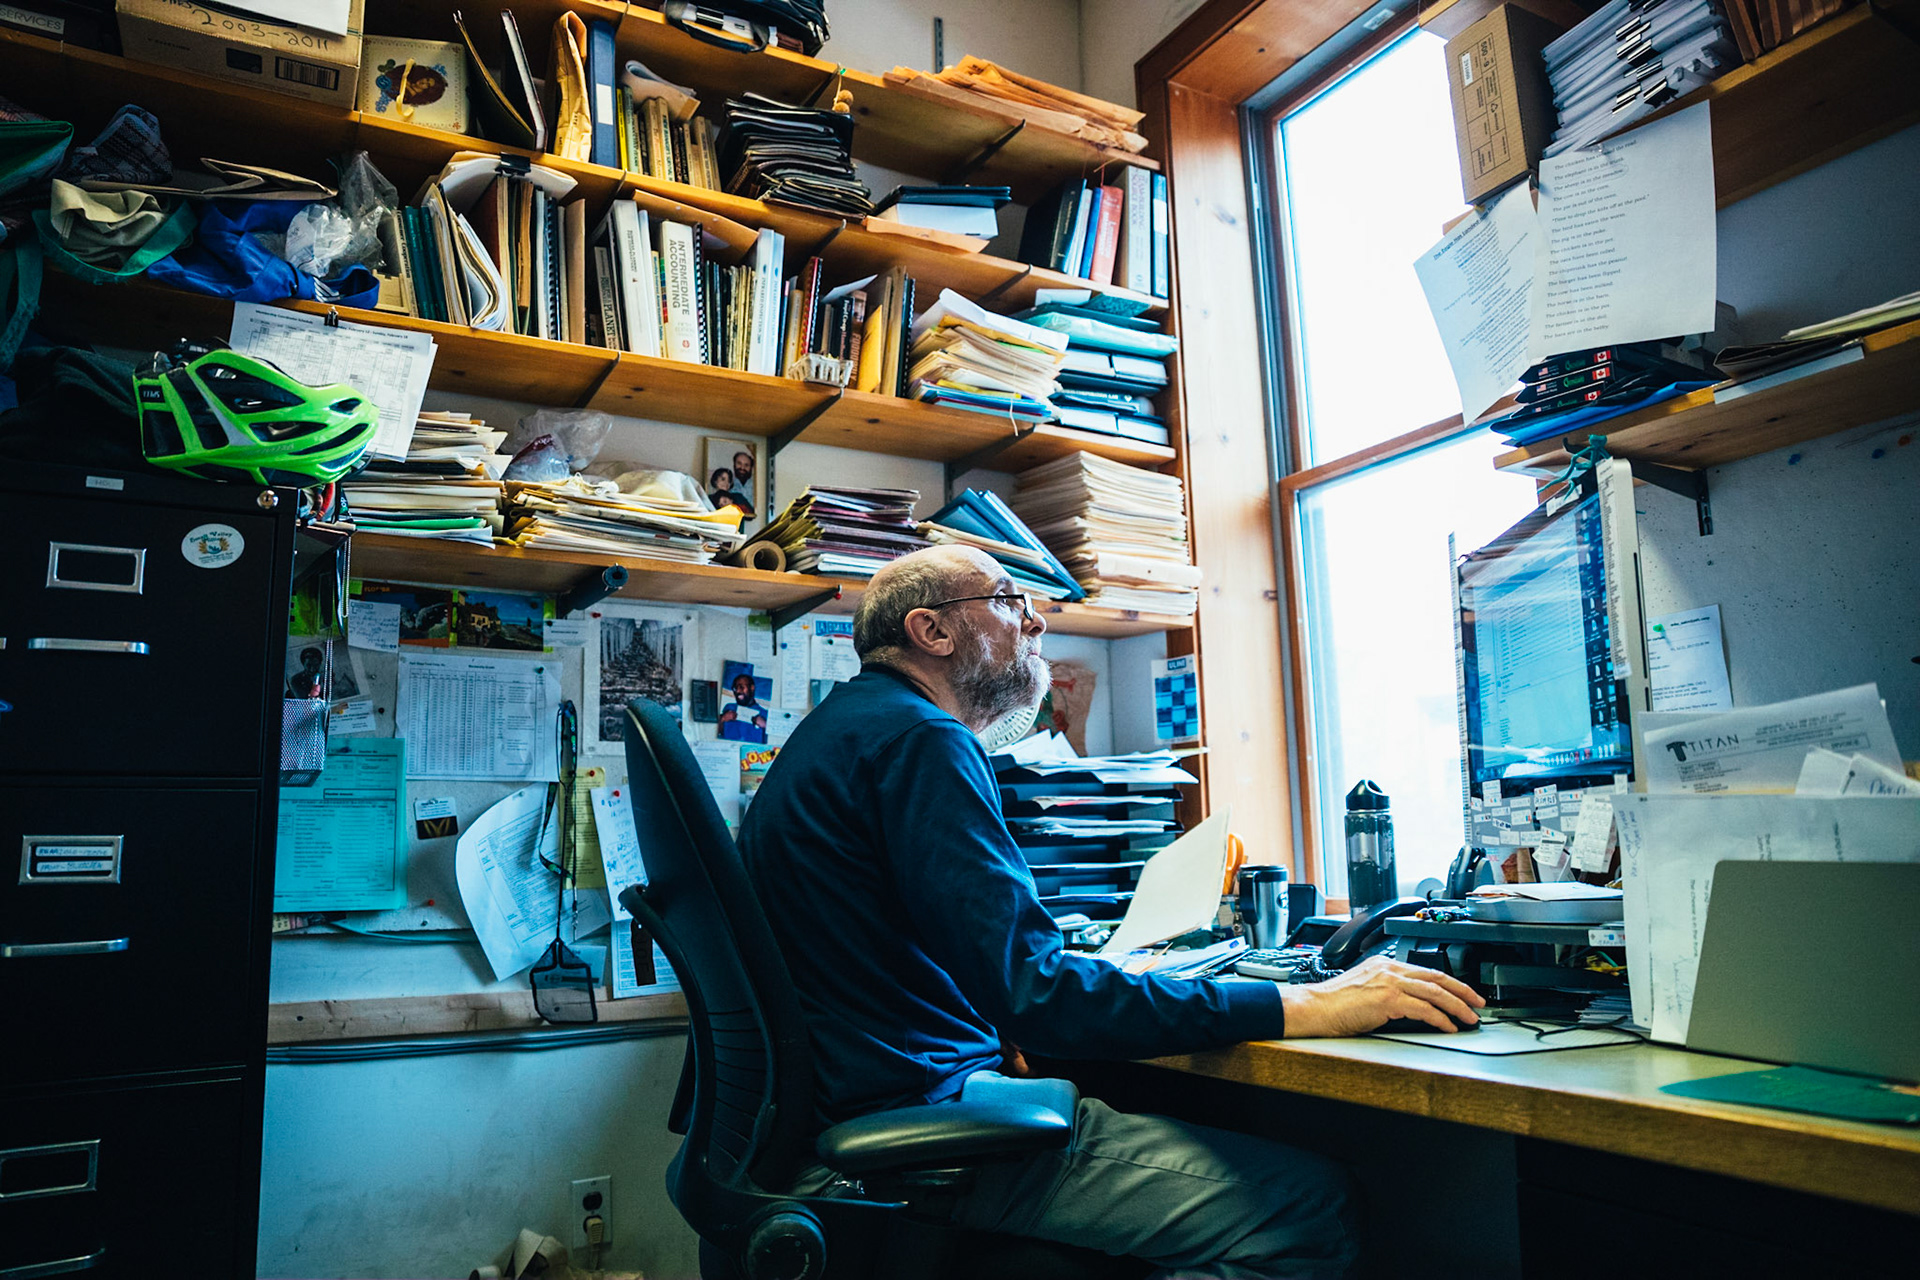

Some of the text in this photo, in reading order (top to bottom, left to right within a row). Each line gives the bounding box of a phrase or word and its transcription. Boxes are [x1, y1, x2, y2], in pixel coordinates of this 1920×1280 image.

[0, 6, 62, 31] SERVICES
[669, 239, 681, 309] ACCOUNTING
[677, 240, 690, 316] INTERMEDIATE
[603, 301, 616, 337] PLANET
[1168, 658, 1186, 669] ULINE
[1688, 734, 1740, 752] TITAN
